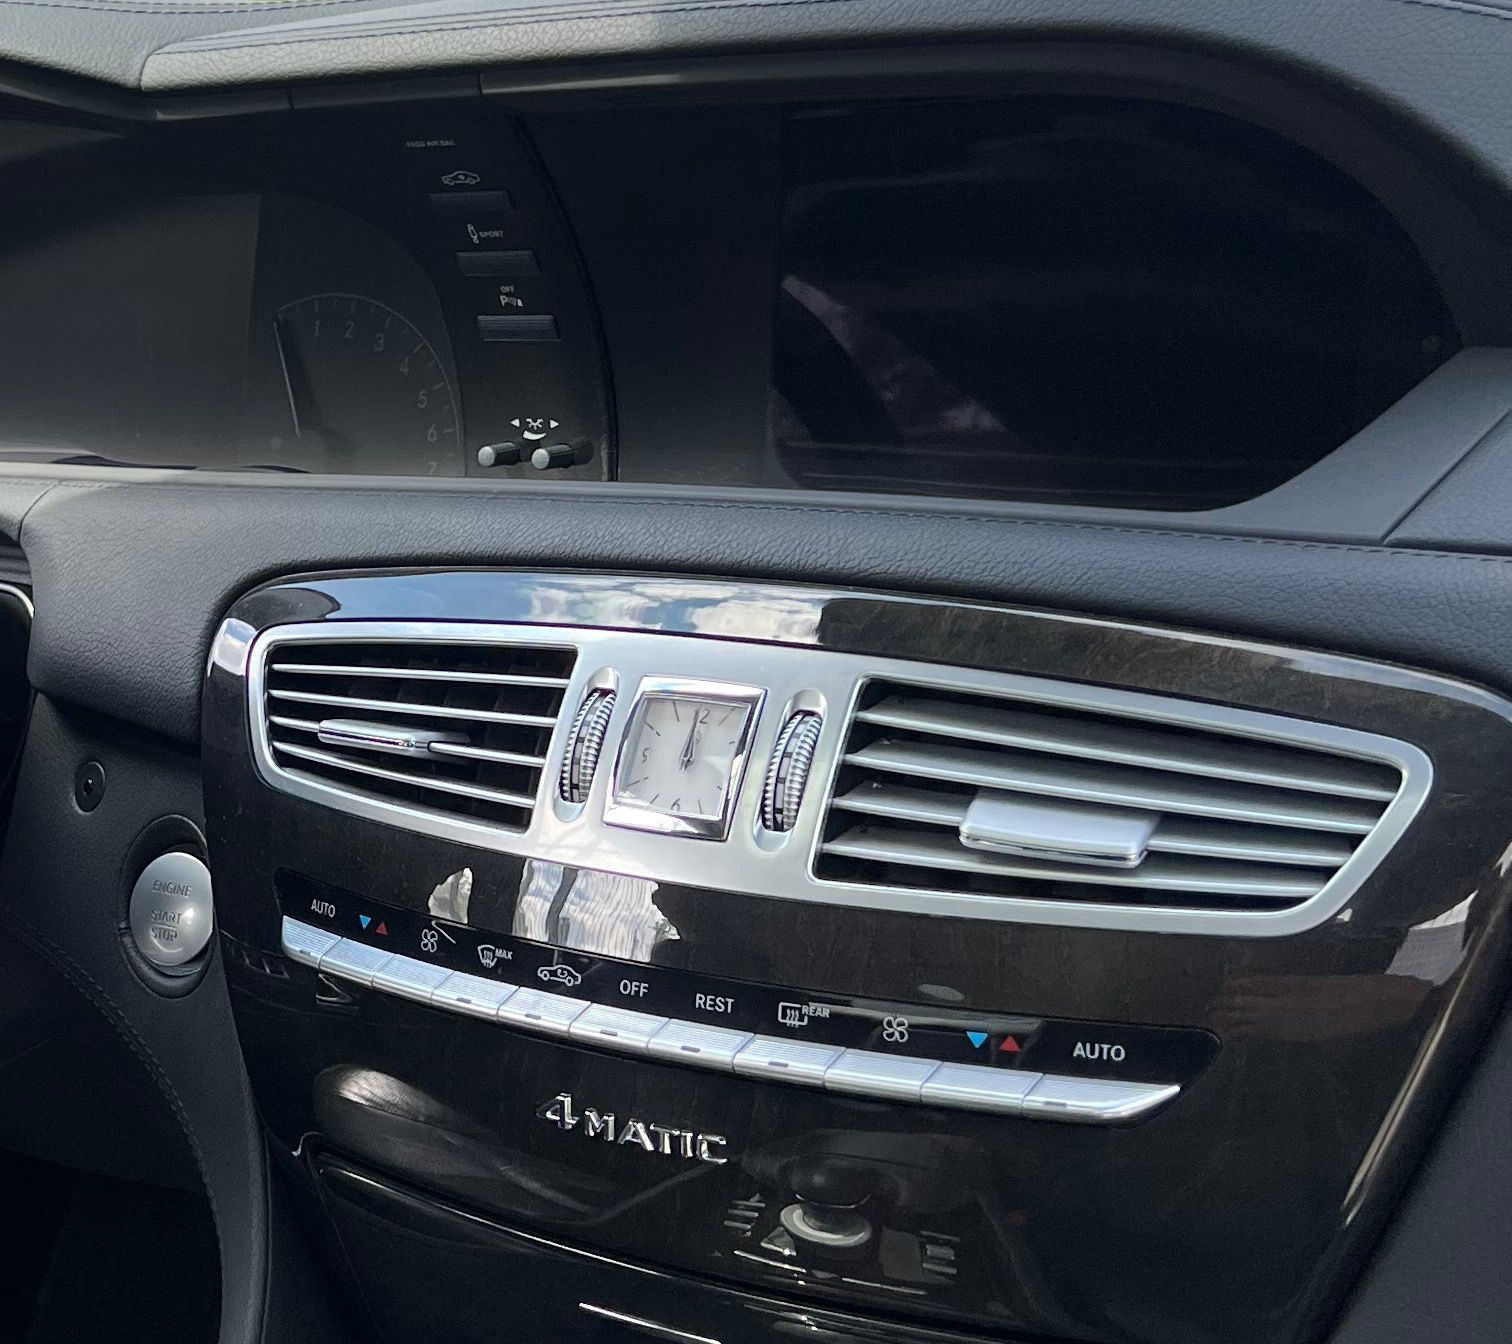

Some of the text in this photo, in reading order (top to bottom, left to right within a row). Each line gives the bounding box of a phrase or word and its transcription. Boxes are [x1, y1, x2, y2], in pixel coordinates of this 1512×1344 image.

[344, 320, 354, 339] 2
[374, 333, 384, 352] 3
[400, 357, 410, 376] 4
[418, 390, 428, 408] 5
[428, 424, 437, 442] 6
[152, 879, 192, 897] ENGINE
[151, 908, 183, 925] START
[311, 898, 336, 918] AUTO
[151, 926, 178, 942] STOP
[495, 947, 513, 960] MAX
[619, 979, 649, 998] OFF
[695, 993, 735, 1014] REST
[801, 1005, 830, 1019] REAR
[1072, 1041, 1126, 1062] AUTO
[536, 1092, 728, 1165] 4MATIC
